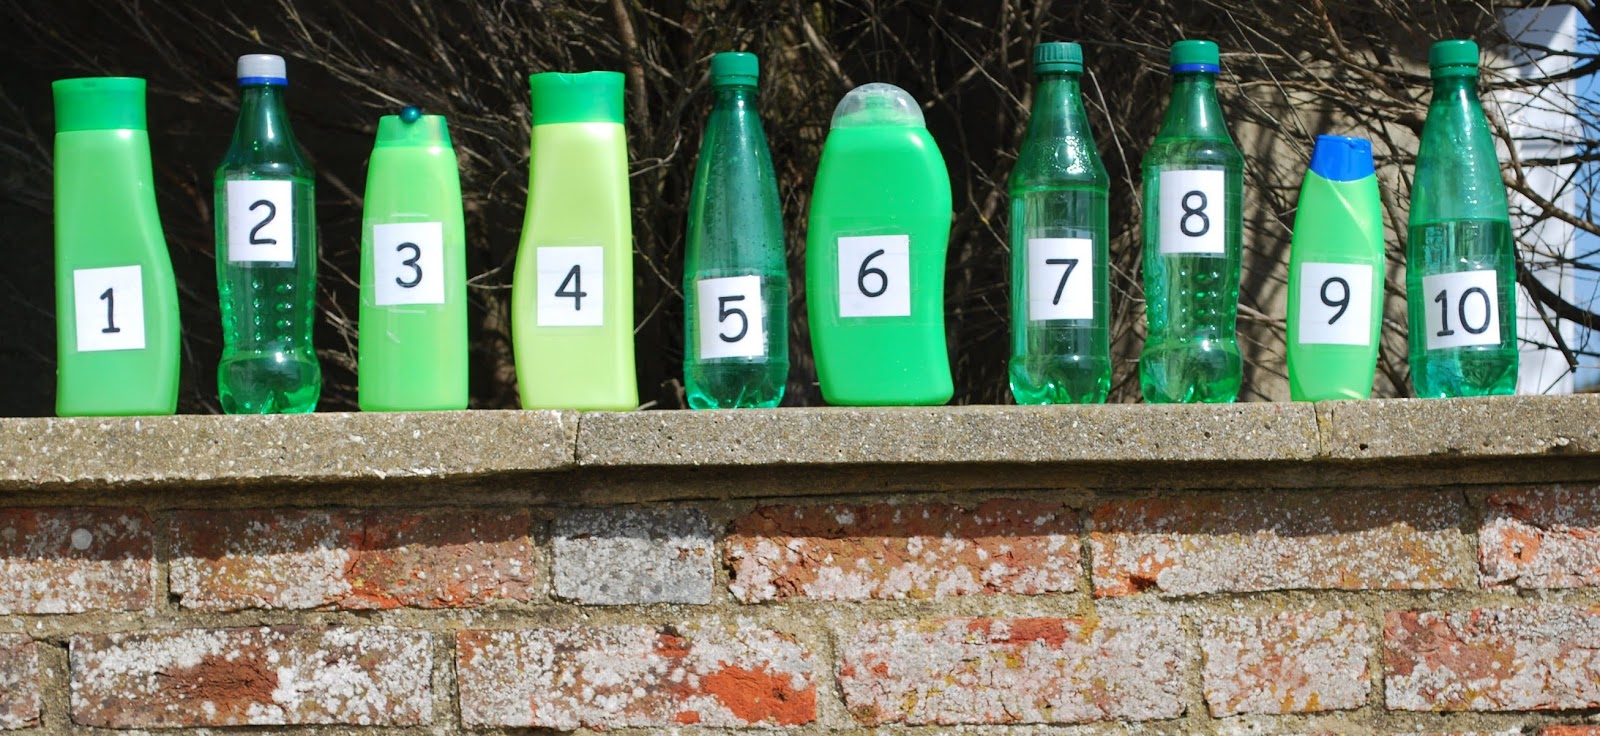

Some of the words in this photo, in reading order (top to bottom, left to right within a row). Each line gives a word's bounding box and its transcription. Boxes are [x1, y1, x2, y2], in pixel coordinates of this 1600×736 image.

[249, 199, 277, 245] 2
[1180, 190, 1211, 238] 8
[396, 242, 423, 289] 3
[554, 264, 587, 311] 4
[857, 249, 888, 298] 6
[1045, 258, 1079, 306] 7
[100, 288, 121, 333] 1
[718, 295, 748, 343] 5
[1320, 276, 1351, 325] 9
[1434, 287, 1491, 337] 10
